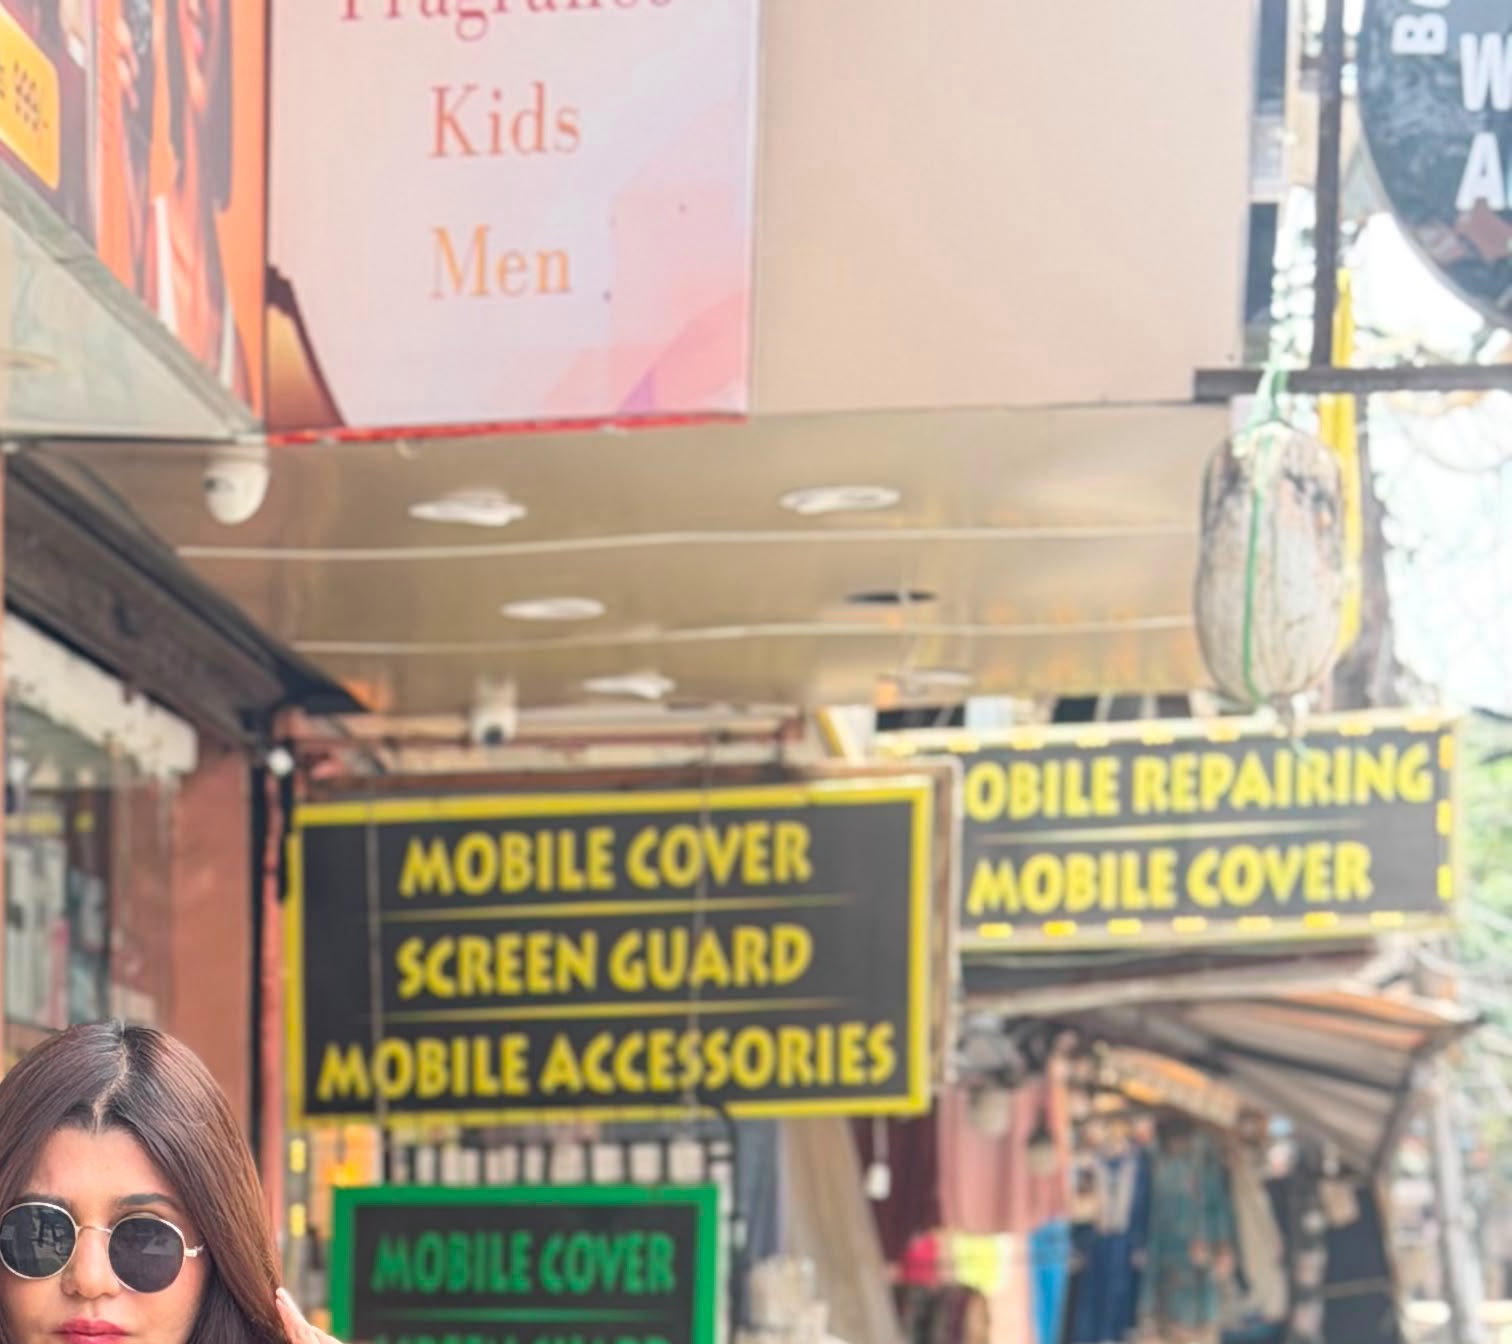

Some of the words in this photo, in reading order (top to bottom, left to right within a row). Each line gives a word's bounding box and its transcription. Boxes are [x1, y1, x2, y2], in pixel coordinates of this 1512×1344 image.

[428, 80, 582, 159] Kids
[429, 224, 573, 300] Men
[1131, 743, 1432, 816] REPAIRING
[399, 828, 613, 897] MOBILE
[625, 821, 811, 891] COVER
[965, 848, 1174, 917] MOBILE
[1185, 841, 1374, 908] COVER
[396, 930, 597, 1000] SCREEN
[608, 923, 812, 994] GUARD
[316, 1032, 529, 1102] MOBILE
[539, 1021, 896, 1098] ACCESSORIES
[372, 1230, 532, 1295] MOBILE
[538, 1231, 676, 1296] COVER
